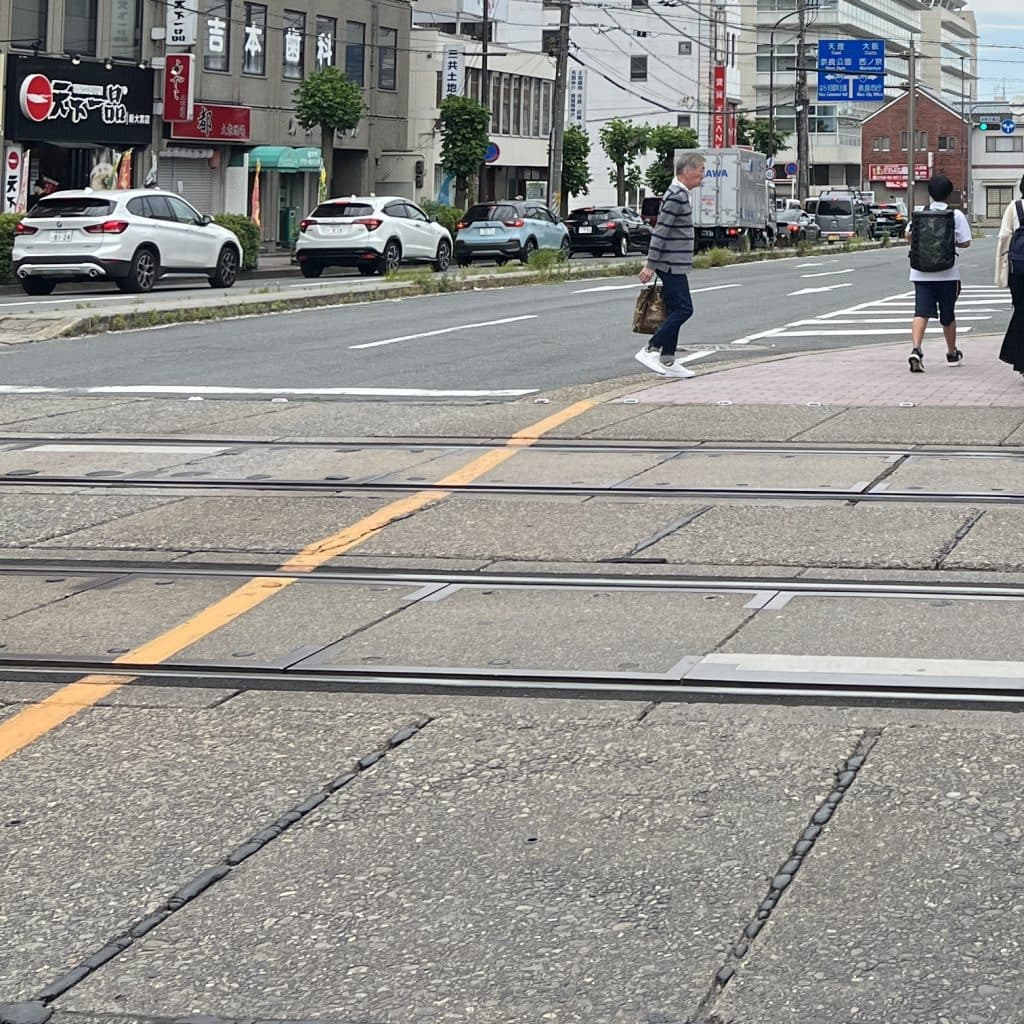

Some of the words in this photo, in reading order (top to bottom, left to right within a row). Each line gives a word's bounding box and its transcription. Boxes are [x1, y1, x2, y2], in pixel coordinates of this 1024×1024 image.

[206, 17, 333, 68] 吉本歯科
[49, 79, 128, 125] 天下一品
